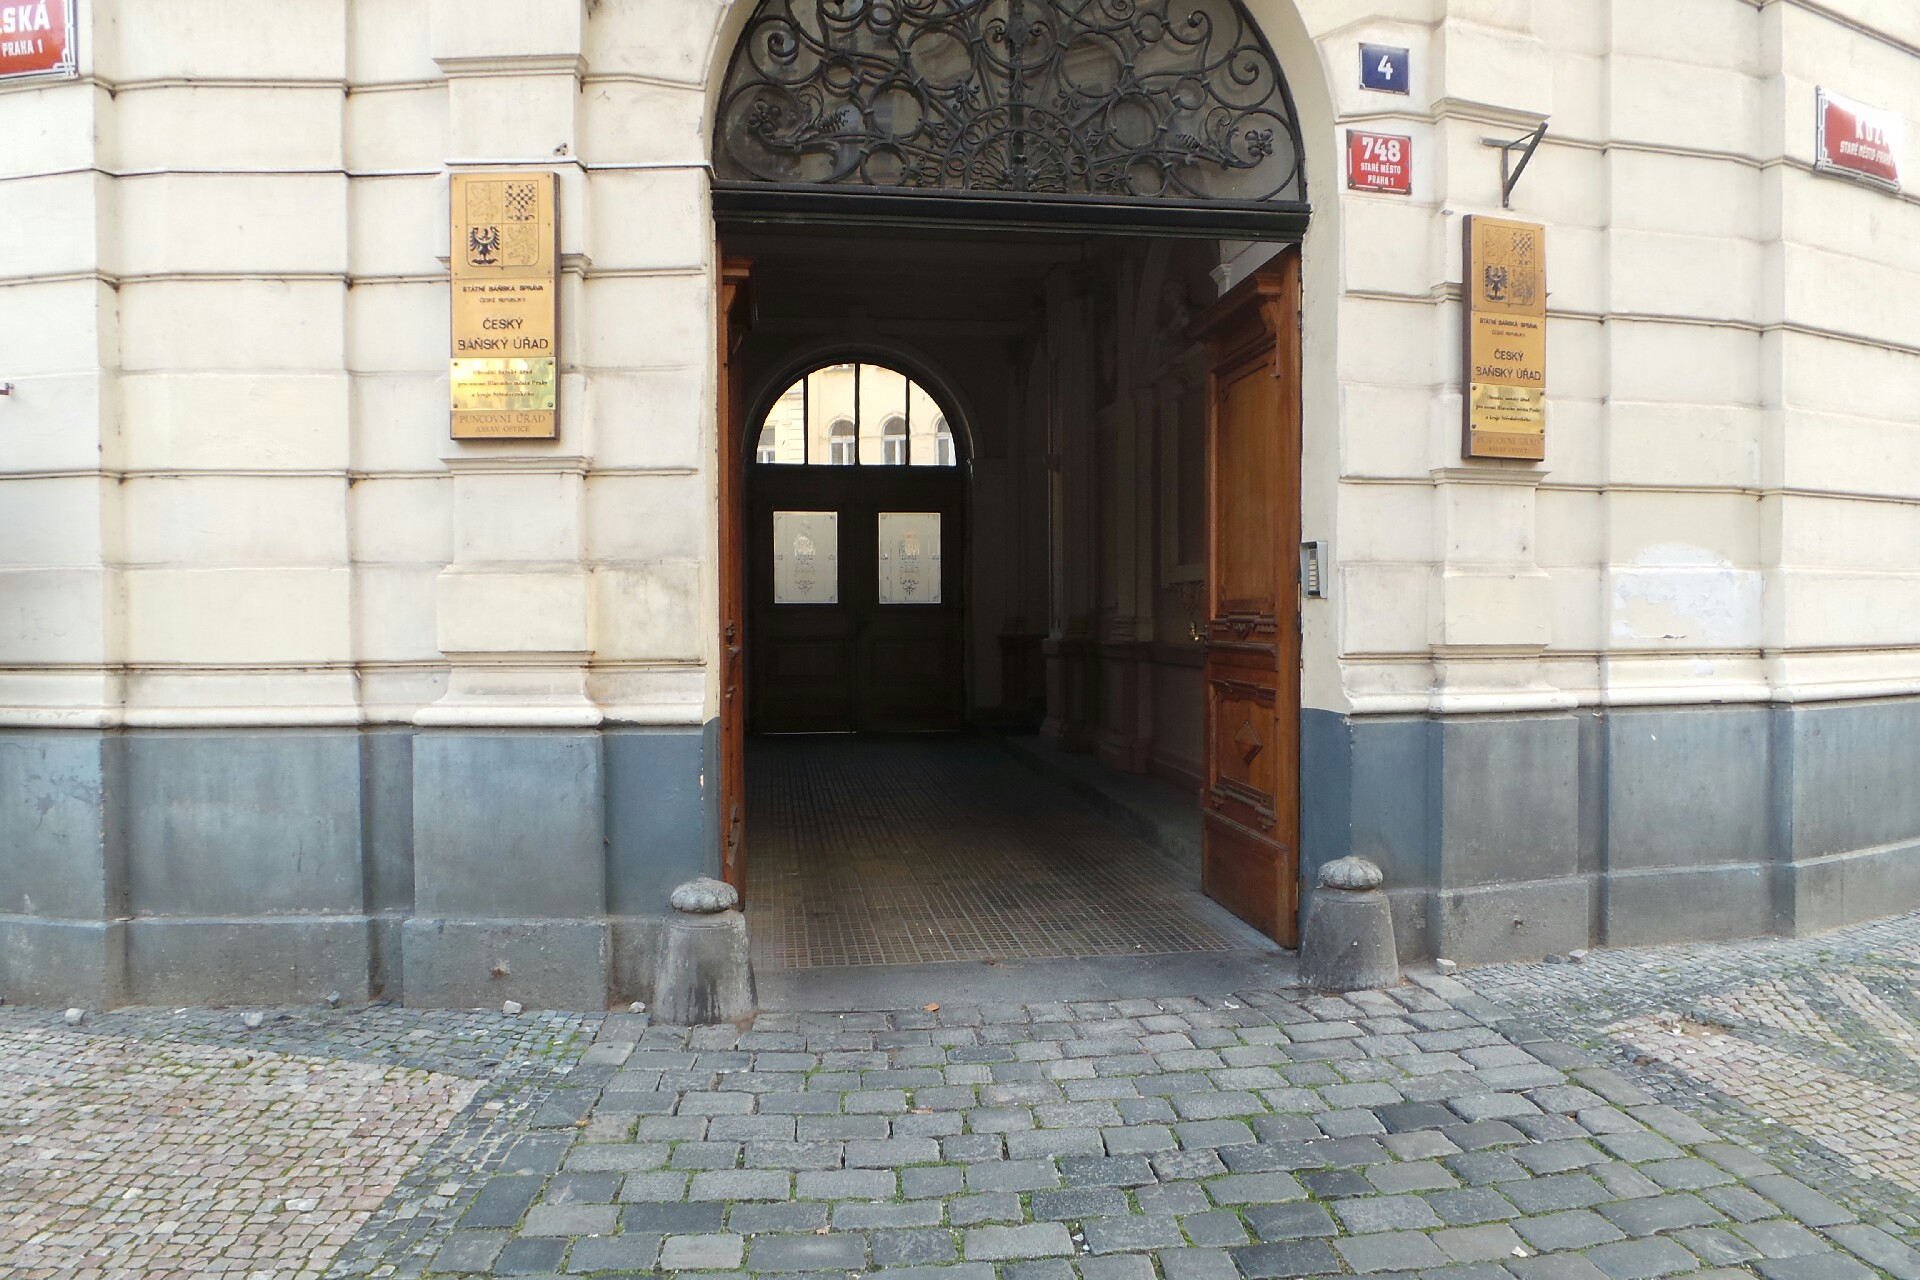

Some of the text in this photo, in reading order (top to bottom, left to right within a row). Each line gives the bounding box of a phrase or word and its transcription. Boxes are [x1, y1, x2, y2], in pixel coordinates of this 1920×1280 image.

[0, 0, 51, 34] SKÁ
[2, 39, 43, 57] PRAHA 1
[1377, 55, 1393, 80] 4
[1362, 136, 1401, 162] 748
[1360, 161, 1401, 175] STARÉ MĚSTO
[1367, 174, 1394, 186] PRAHA 1
[482, 316, 523, 330] ČESKÝ
[458, 336, 549, 351] BÁŇSKÝ ÚŘAD
[1494, 347, 1524, 361] ČESKÝ
[1475, 364, 1541, 381] BÁŇSKÝ ÚŘAD
